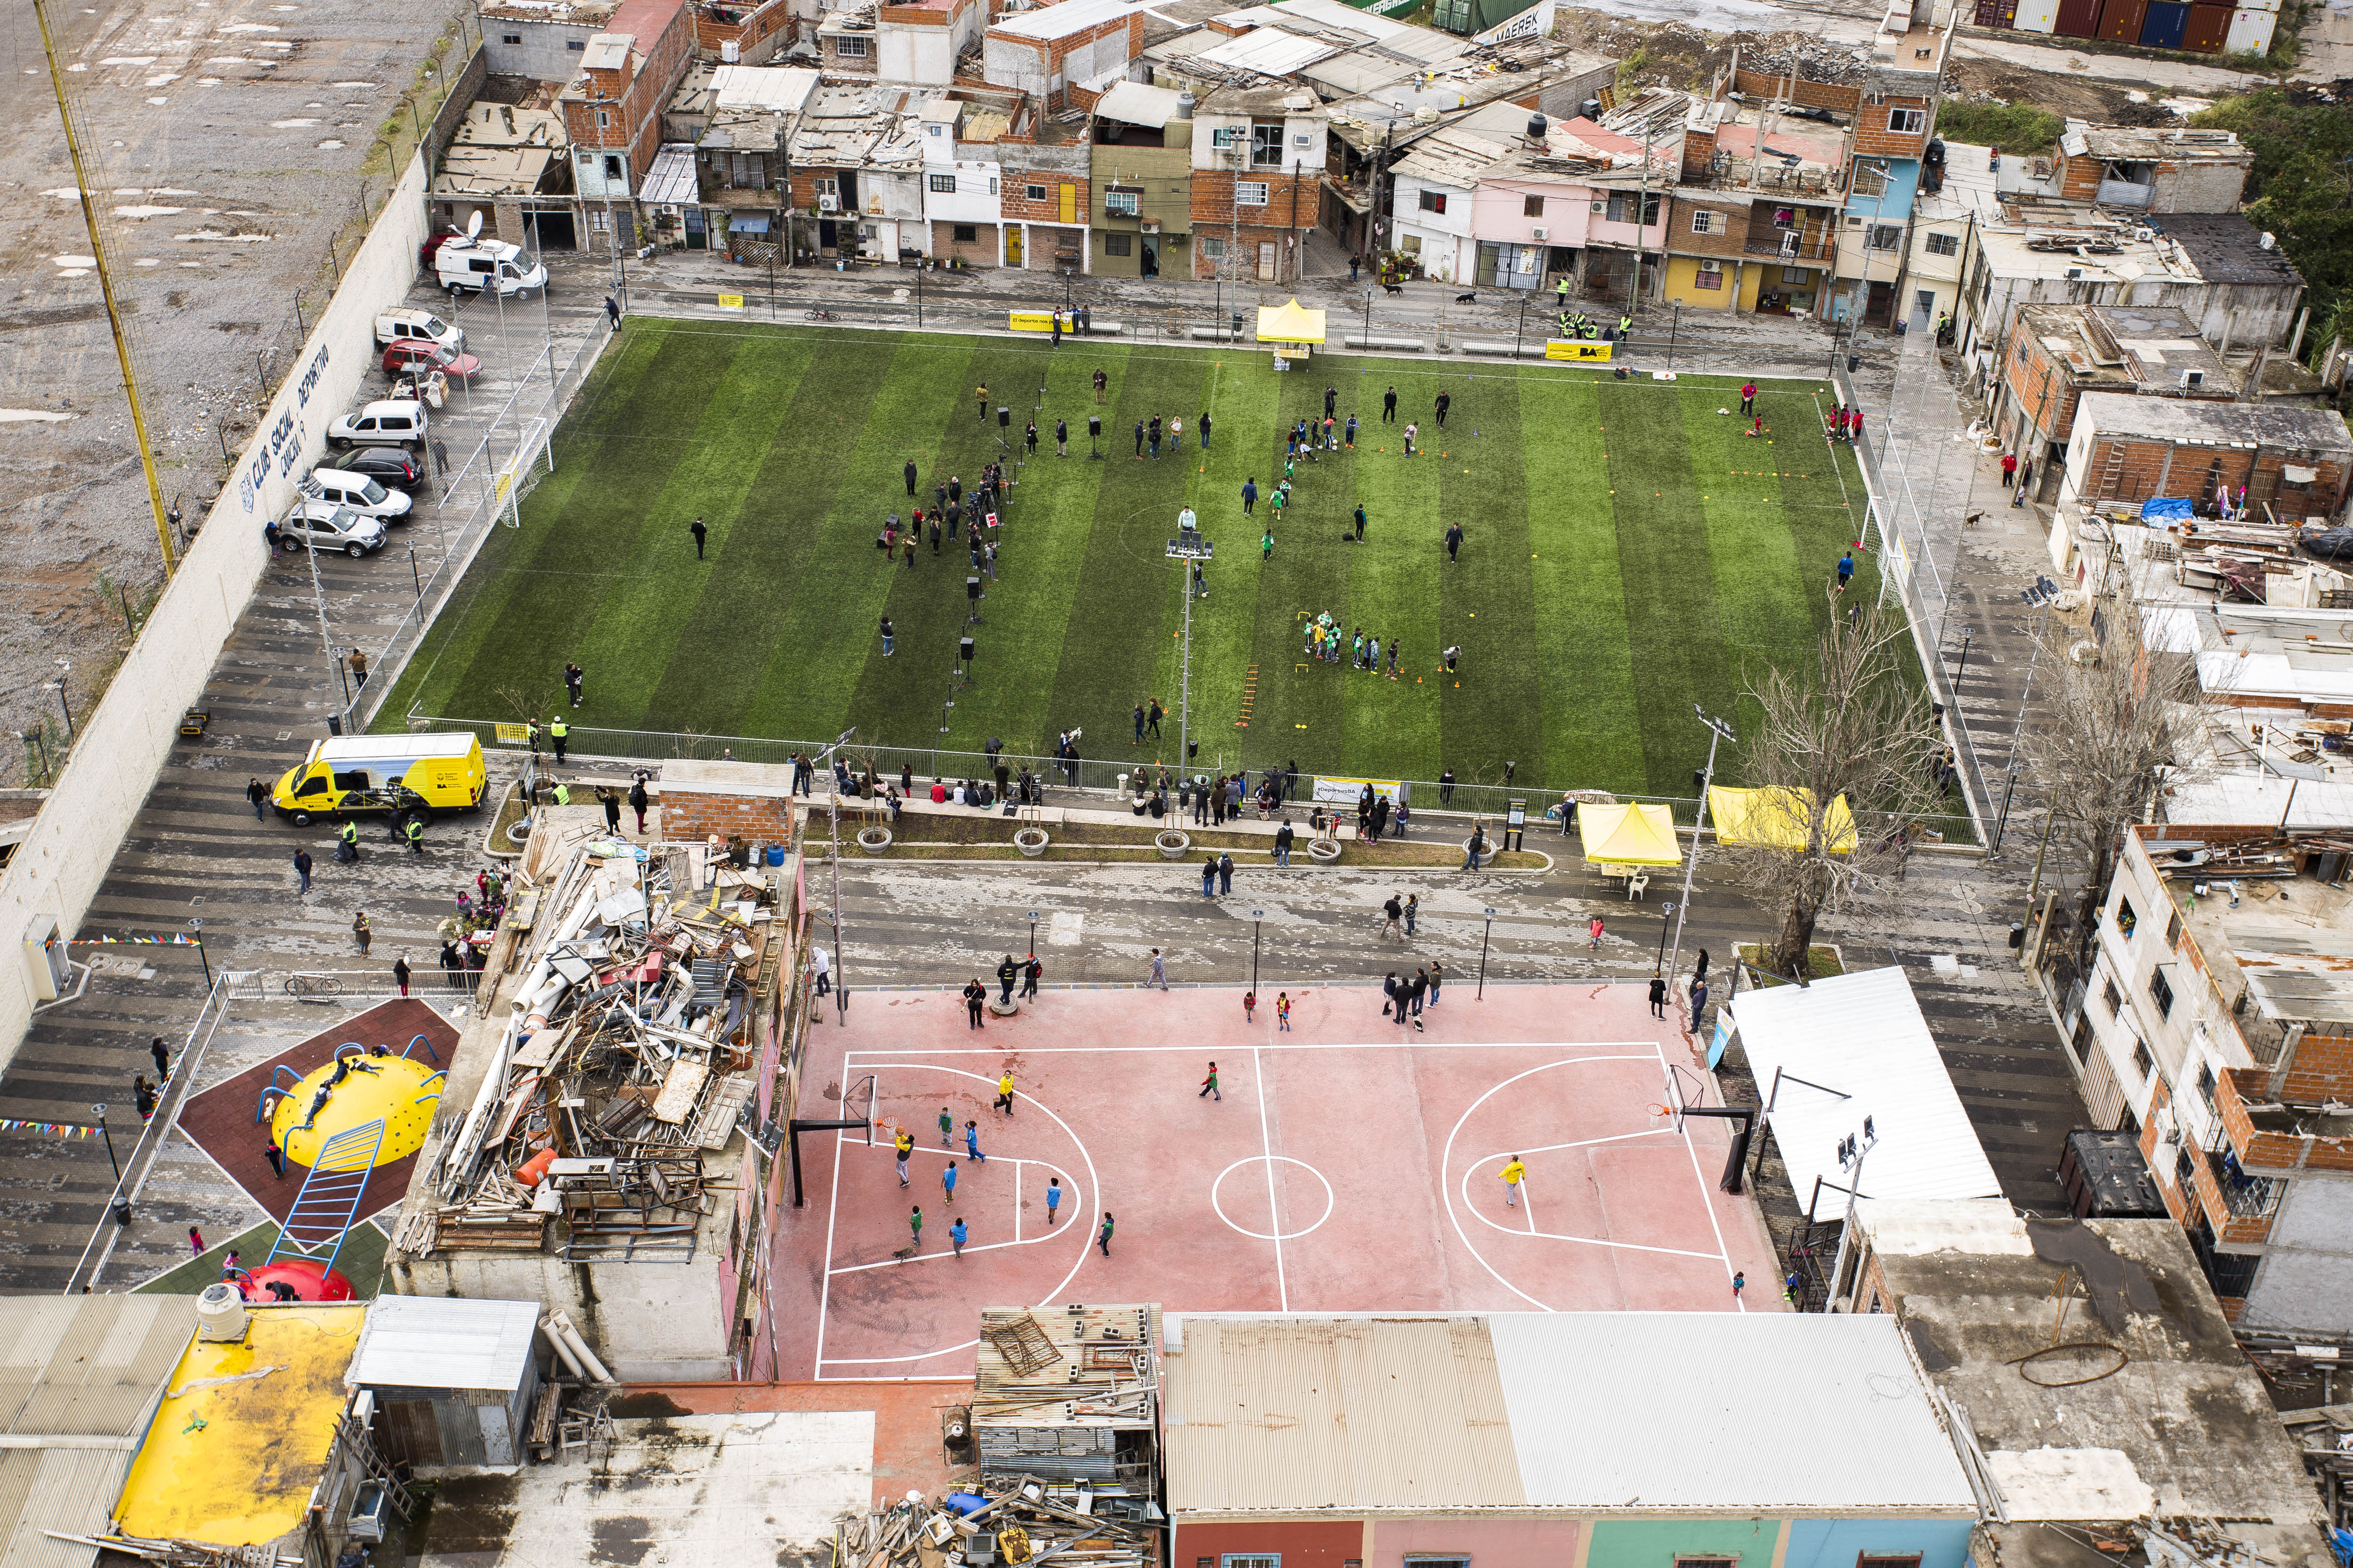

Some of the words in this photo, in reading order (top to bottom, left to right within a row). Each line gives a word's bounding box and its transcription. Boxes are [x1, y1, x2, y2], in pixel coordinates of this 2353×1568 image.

[1497, 10, 1539, 42] MAERSK
[1580, 347, 1597, 357] BA
[253, 444, 270, 490] CLUB
[271, 406, 294, 456] SOCIAL
[298, 343, 329, 410] DEPORTIVO
[280, 434, 301, 479] CANCHA
[1375, 789, 1394, 798] BA
